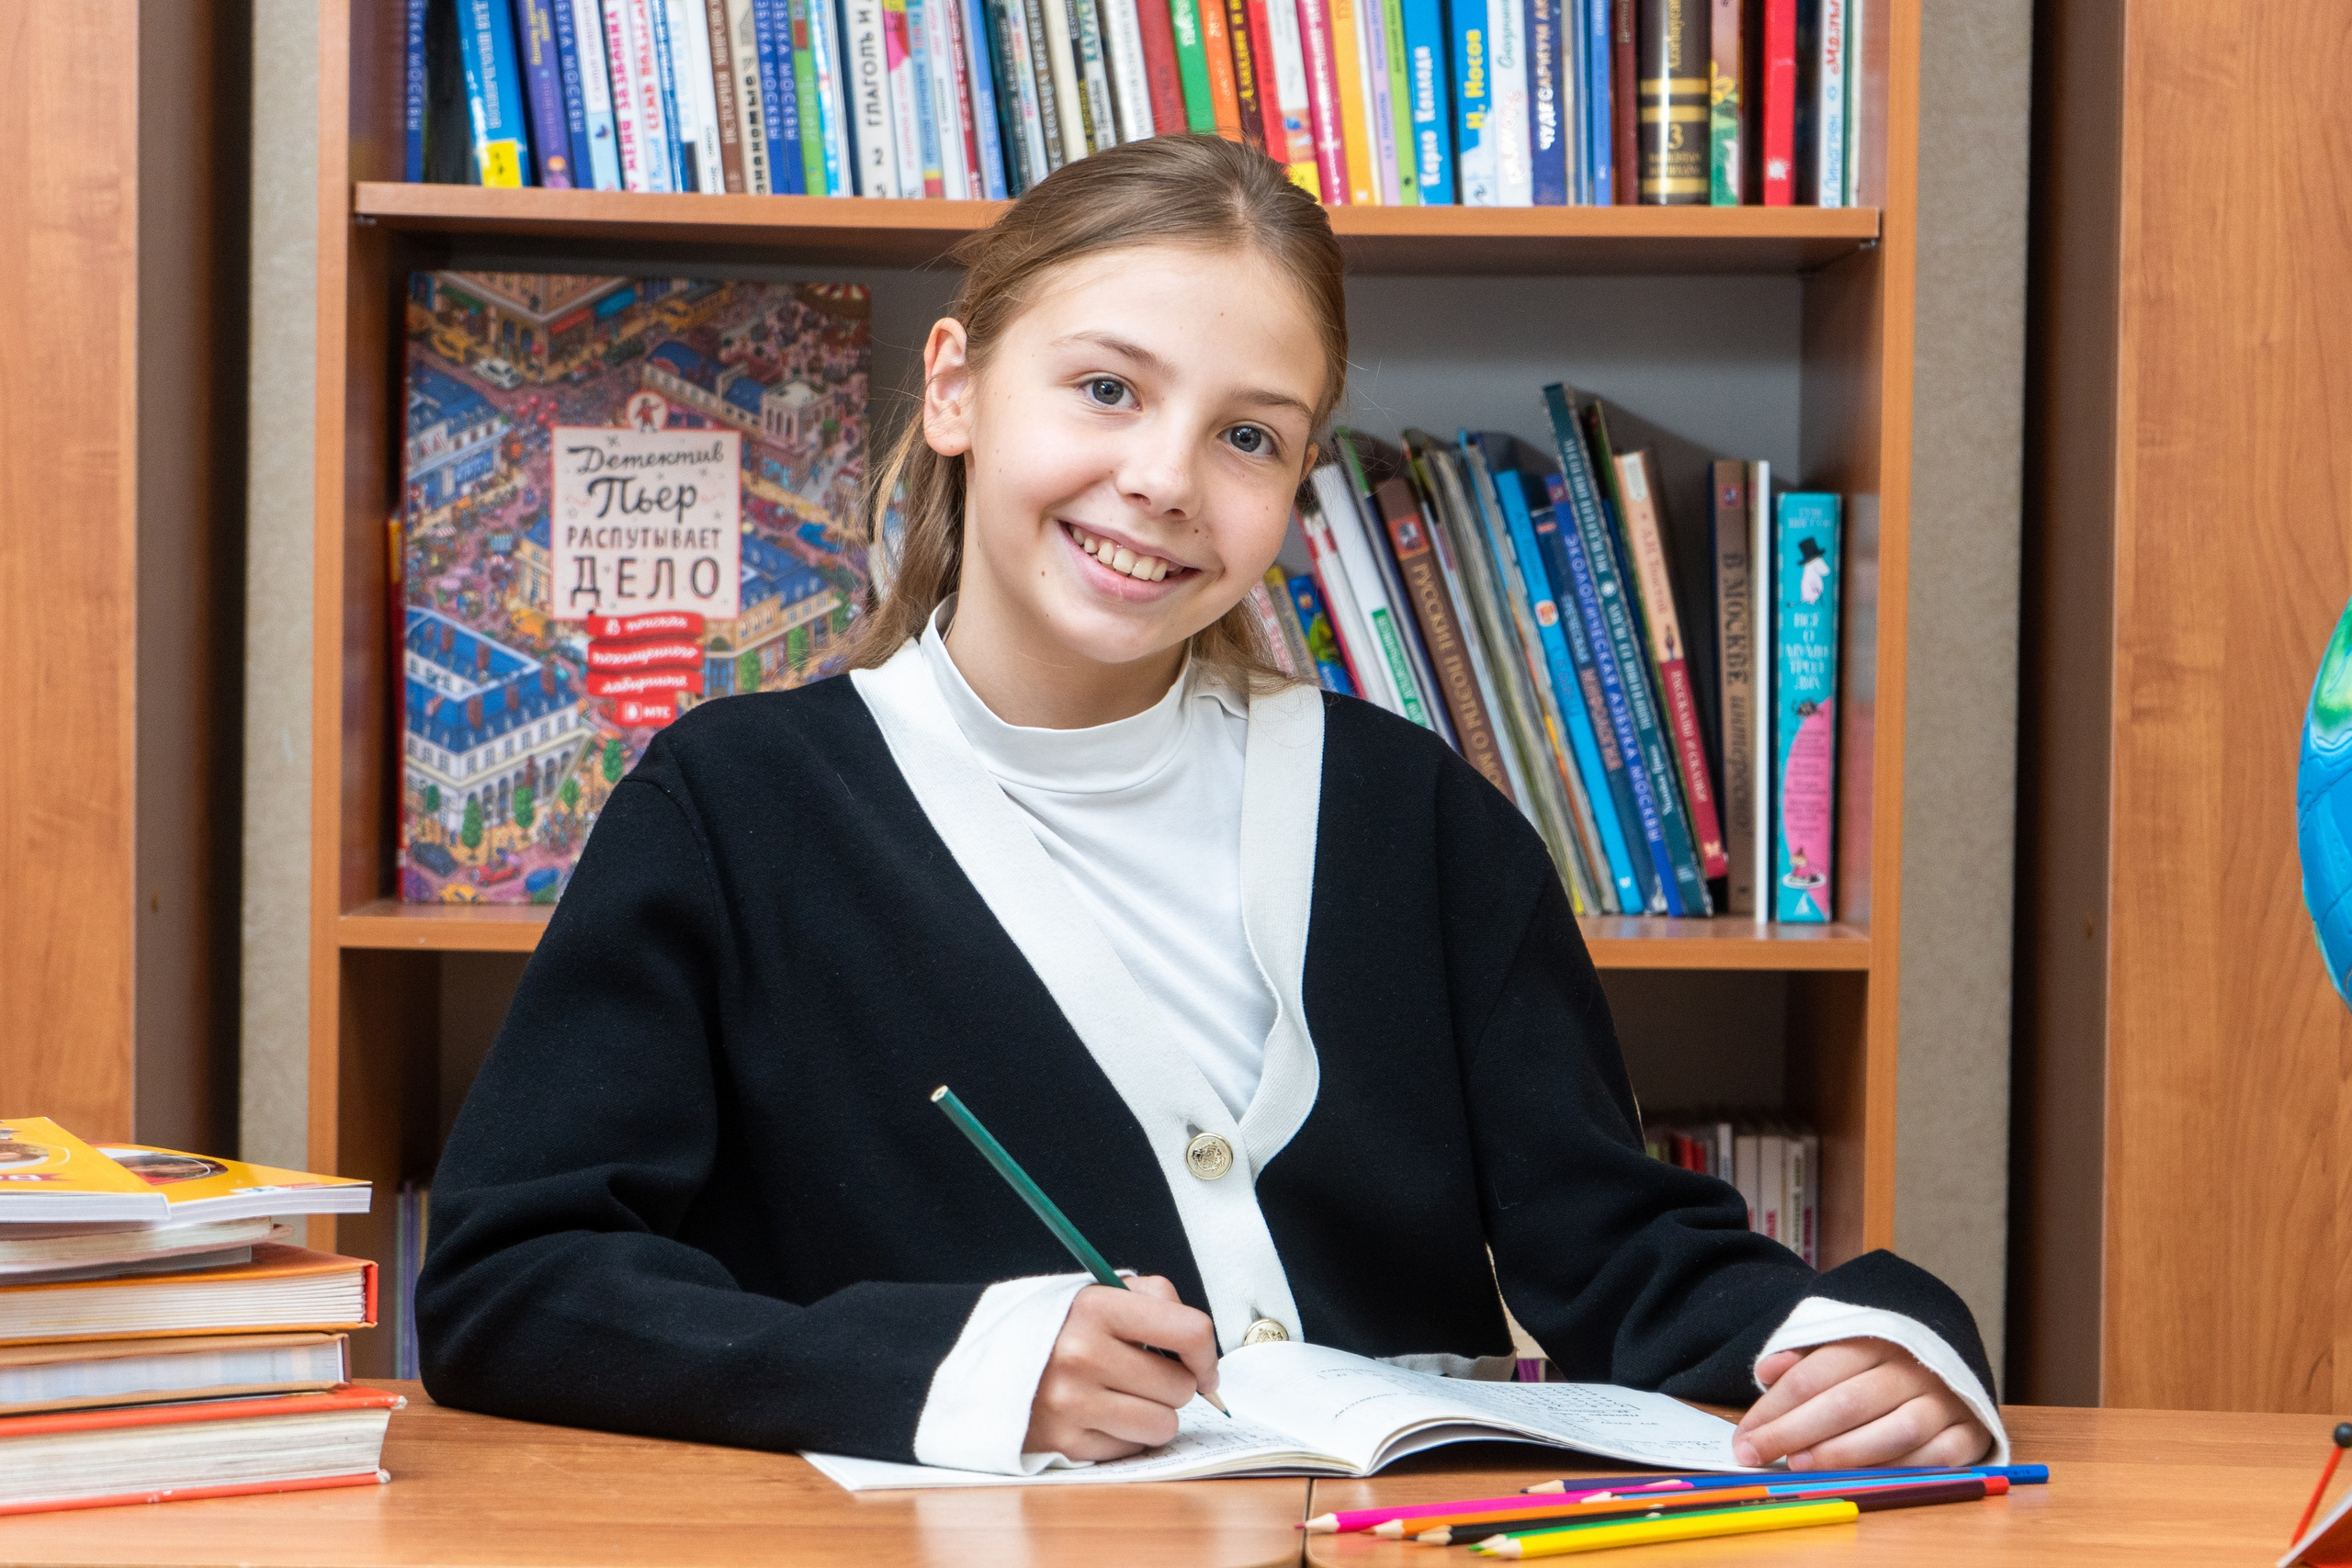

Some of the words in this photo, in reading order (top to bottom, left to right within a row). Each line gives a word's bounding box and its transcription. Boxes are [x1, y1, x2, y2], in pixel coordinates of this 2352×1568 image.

[408, 52, 423, 130] МОСКВЫ
[478, 31, 503, 130] ШКОЛЬНИКОВ
[563, 54, 584, 133] МОСКВЫ
[606, 11, 630, 110] ЗАЗВОНИЛ
[859, 30, 883, 128] ГЛАГОЛЪ
[1414, 46, 1438, 122] Коллоди
[1464, 29, 1485, 98] Носов
[1534, 24, 1556, 151] ЧУДЕСАРИУМ
[644, 84, 660, 130] СЕМЬ
[717, 71, 738, 144] ИСТОРИЯ
[761, 62, 781, 140] МОСКВЫ
[780, 62, 799, 140] МОСКВЫ
[1038, 73, 1060, 138] КОЛЬЦА
[1464, 104, 1487, 130] Н.
[620, 120, 638, 172] МЕНЯ
[1419, 125, 1443, 186] Карло
[1668, 124, 1683, 149] 3
[566, 441, 724, 475] Детектив
[586, 476, 698, 525] Пьер
[567, 525, 723, 550] РАСПУТЫВАЕТ
[1722, 552, 1742, 568] В
[570, 556, 720, 607] ДЕЛО
[592, 646, 699, 665] похищенного
[605, 618, 621, 636] В
[626, 615, 688, 633] поисках
[1412, 561, 1457, 655] РУССКИЕ
[1443, 653, 1484, 730] ПОЭТЫ
[1474, 729, 1490, 750] О
[1723, 577, 1747, 684] МОСКВЕ
[600, 676, 688, 694] лабиринта
[644, 706, 671, 719] МТС
[1563, 533, 1619, 686] ЭКОЛОГИЧЕСКАЯ
[1608, 691, 1638, 760] АЗБУКА
[1628, 765, 1663, 842] МОСКВЫ
[1579, 667, 1623, 771] МИФОЛОГИЯ
[1668, 669, 1694, 738] РАССКАЗЫ
[1686, 750, 1708, 802] СКАЗКИ
